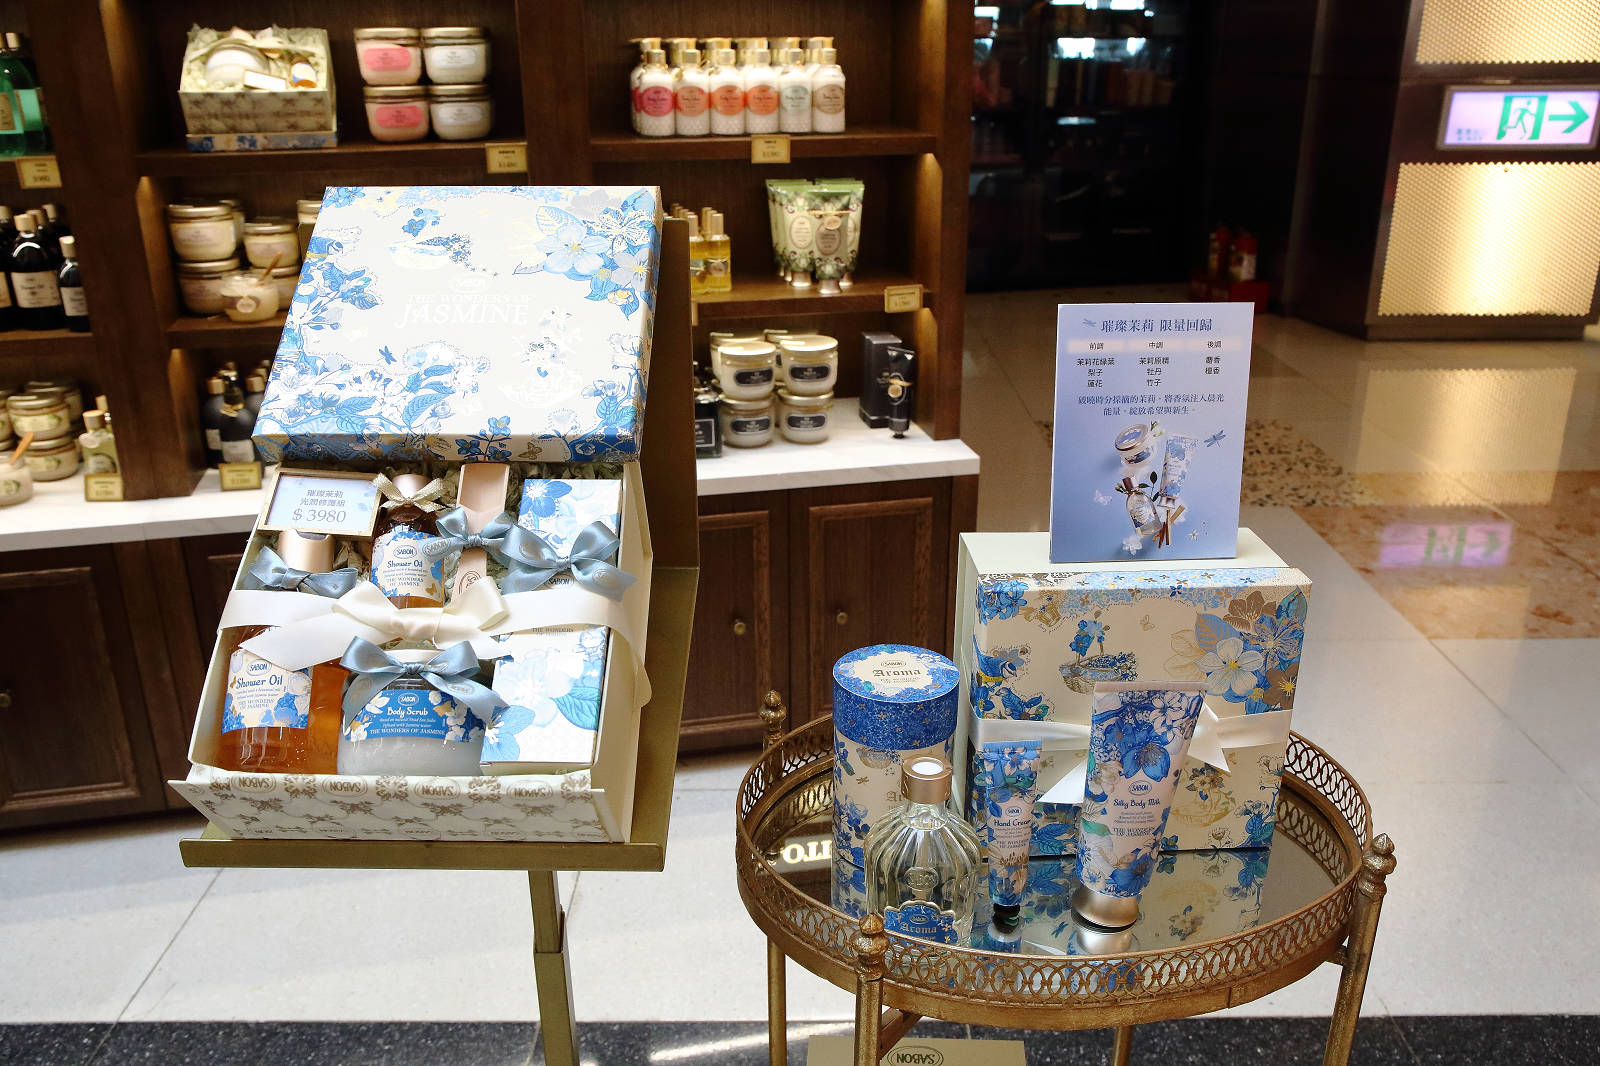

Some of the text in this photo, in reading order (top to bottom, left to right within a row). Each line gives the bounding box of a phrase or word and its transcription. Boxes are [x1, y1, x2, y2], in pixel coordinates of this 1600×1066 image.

[393, 303, 529, 328] JASMINE
[1101, 318, 1213, 333] 璀璨茉莉 限量回歸
[1148, 341, 1163, 349] 中調
[1207, 340, 1222, 348] 後調
[1087, 368, 1104, 377] 梨子
[1146, 367, 1162, 376] 牡丹
[1146, 378, 1162, 387] 竹子
[387, 559, 423, 568] Shower Oil
[250, 663, 268, 671] SABON
[873, 669, 921, 677] Aroma
[236, 674, 283, 689] Shower Oil
[387, 706, 428, 718] Body Scrub
[238, 776, 270, 789] SABON
[329, 780, 361, 793] SABON
[421, 785, 455, 796] SABON
[1113, 799, 1129, 809] Silky
[1130, 799, 1146, 809] Body
[993, 819, 1011, 827] Hand
[900, 922, 937, 934] Aroma
[896, 1053, 935, 1064] SABON
